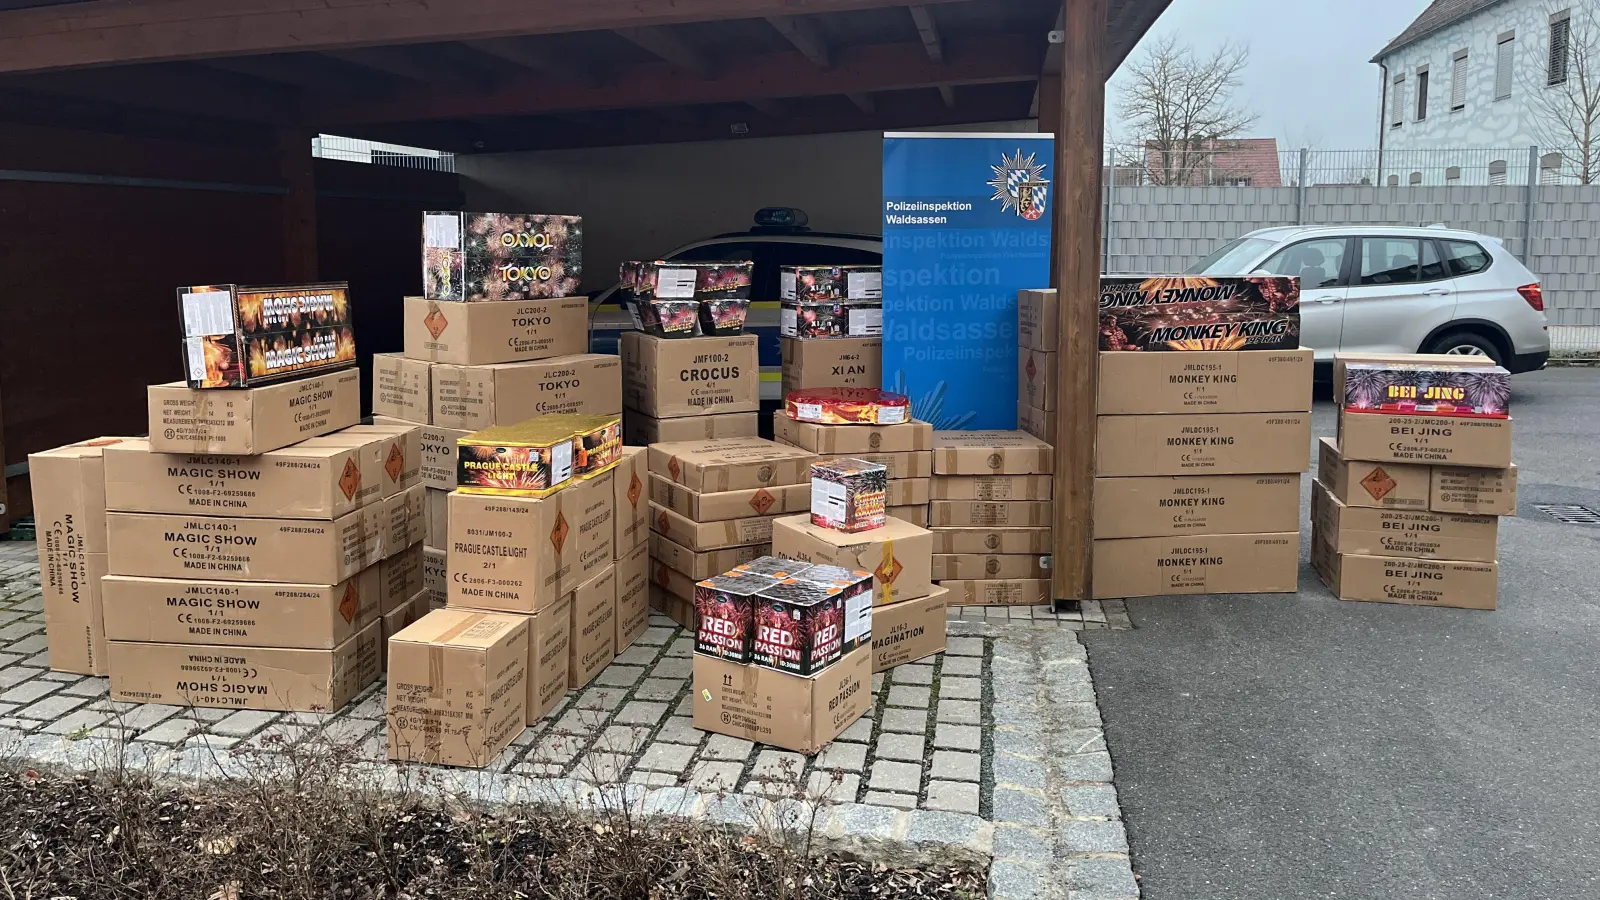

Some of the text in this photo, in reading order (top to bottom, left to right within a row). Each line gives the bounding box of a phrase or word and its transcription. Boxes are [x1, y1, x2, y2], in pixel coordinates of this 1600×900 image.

[886, 201, 972, 212] Polizeiinspektion
[886, 215, 947, 224] Waldsassen
[501, 232, 553, 251] TOKYO
[883, 231, 1049, 252] inspektion Walds
[499, 263, 552, 283] TOKYO
[883, 263, 1000, 292] spektion
[1100, 284, 1237, 308] MONKEY KING
[517, 307, 547, 315] JLC200-2
[512, 317, 551, 327] TOKYO
[1150, 319, 1289, 344] MONKEY KING
[1262, 335, 1283, 343] RAN
[266, 342, 336, 369] MAGIC SHOW
[693, 354, 729, 363] JMF100-2
[544, 370, 576, 379] JLC200-2
[680, 366, 740, 382] CROCUS
[832, 365, 865, 376] XI AN
[538, 379, 580, 391] TOKYO
[1169, 375, 1237, 383] MONKEY KING
[298, 381, 324, 392] JMLC140-1
[289, 390, 333, 408] MAGIC SHOW
[1388, 386, 1465, 400] BEI JING
[688, 395, 734, 406] MADE IN CHINA
[1391, 427, 1452, 436] BEI JING
[1167, 437, 1234, 446] MONKEY KING
[420, 443, 450, 455] OKYO
[187, 457, 240, 465] JMLC140-1
[464, 461, 538, 472] PRAGUE CASTLE
[168, 468, 261, 480] MAGIC SHOW
[222, 500, 247, 508] CHINA
[1159, 498, 1225, 507] MONKEY KING
[184, 522, 237, 531] JMLC140-1
[1382, 522, 1441, 532] BEI JING
[164, 532, 257, 546] MAGIC SHOW
[467, 529, 513, 538] 8031/JM100-2
[46, 530, 54, 552] MADE
[455, 542, 527, 558] PRAGUE CASTLE LIGHT
[48, 554, 54, 562] IN
[65, 514, 80, 604] MAGIC SHOW
[1157, 557, 1223, 567] MONKEY KING
[208, 562, 216, 570] IN
[217, 563, 242, 571] CHINA
[1385, 570, 1443, 580] BEI JING
[185, 587, 239, 596] JMLC140-1
[461, 588, 519, 600] MADE IN CHINA
[166, 598, 260, 610] MAGIC SHOW
[189, 627, 211, 635] MADE
[222, 629, 247, 637] CHINA
[702, 617, 737, 636] RED
[699, 630, 743, 649] PASSION
[758, 625, 793, 645] RED
[814, 624, 838, 647] RED
[872, 626, 924, 650] MAGINATION
[754, 641, 800, 660] PASSION
[811, 637, 841, 661] PASSION
[189, 655, 213, 663] CHINA
[176, 681, 268, 695] MAGIC SHOW
[828, 681, 860, 712] RED PASSION
